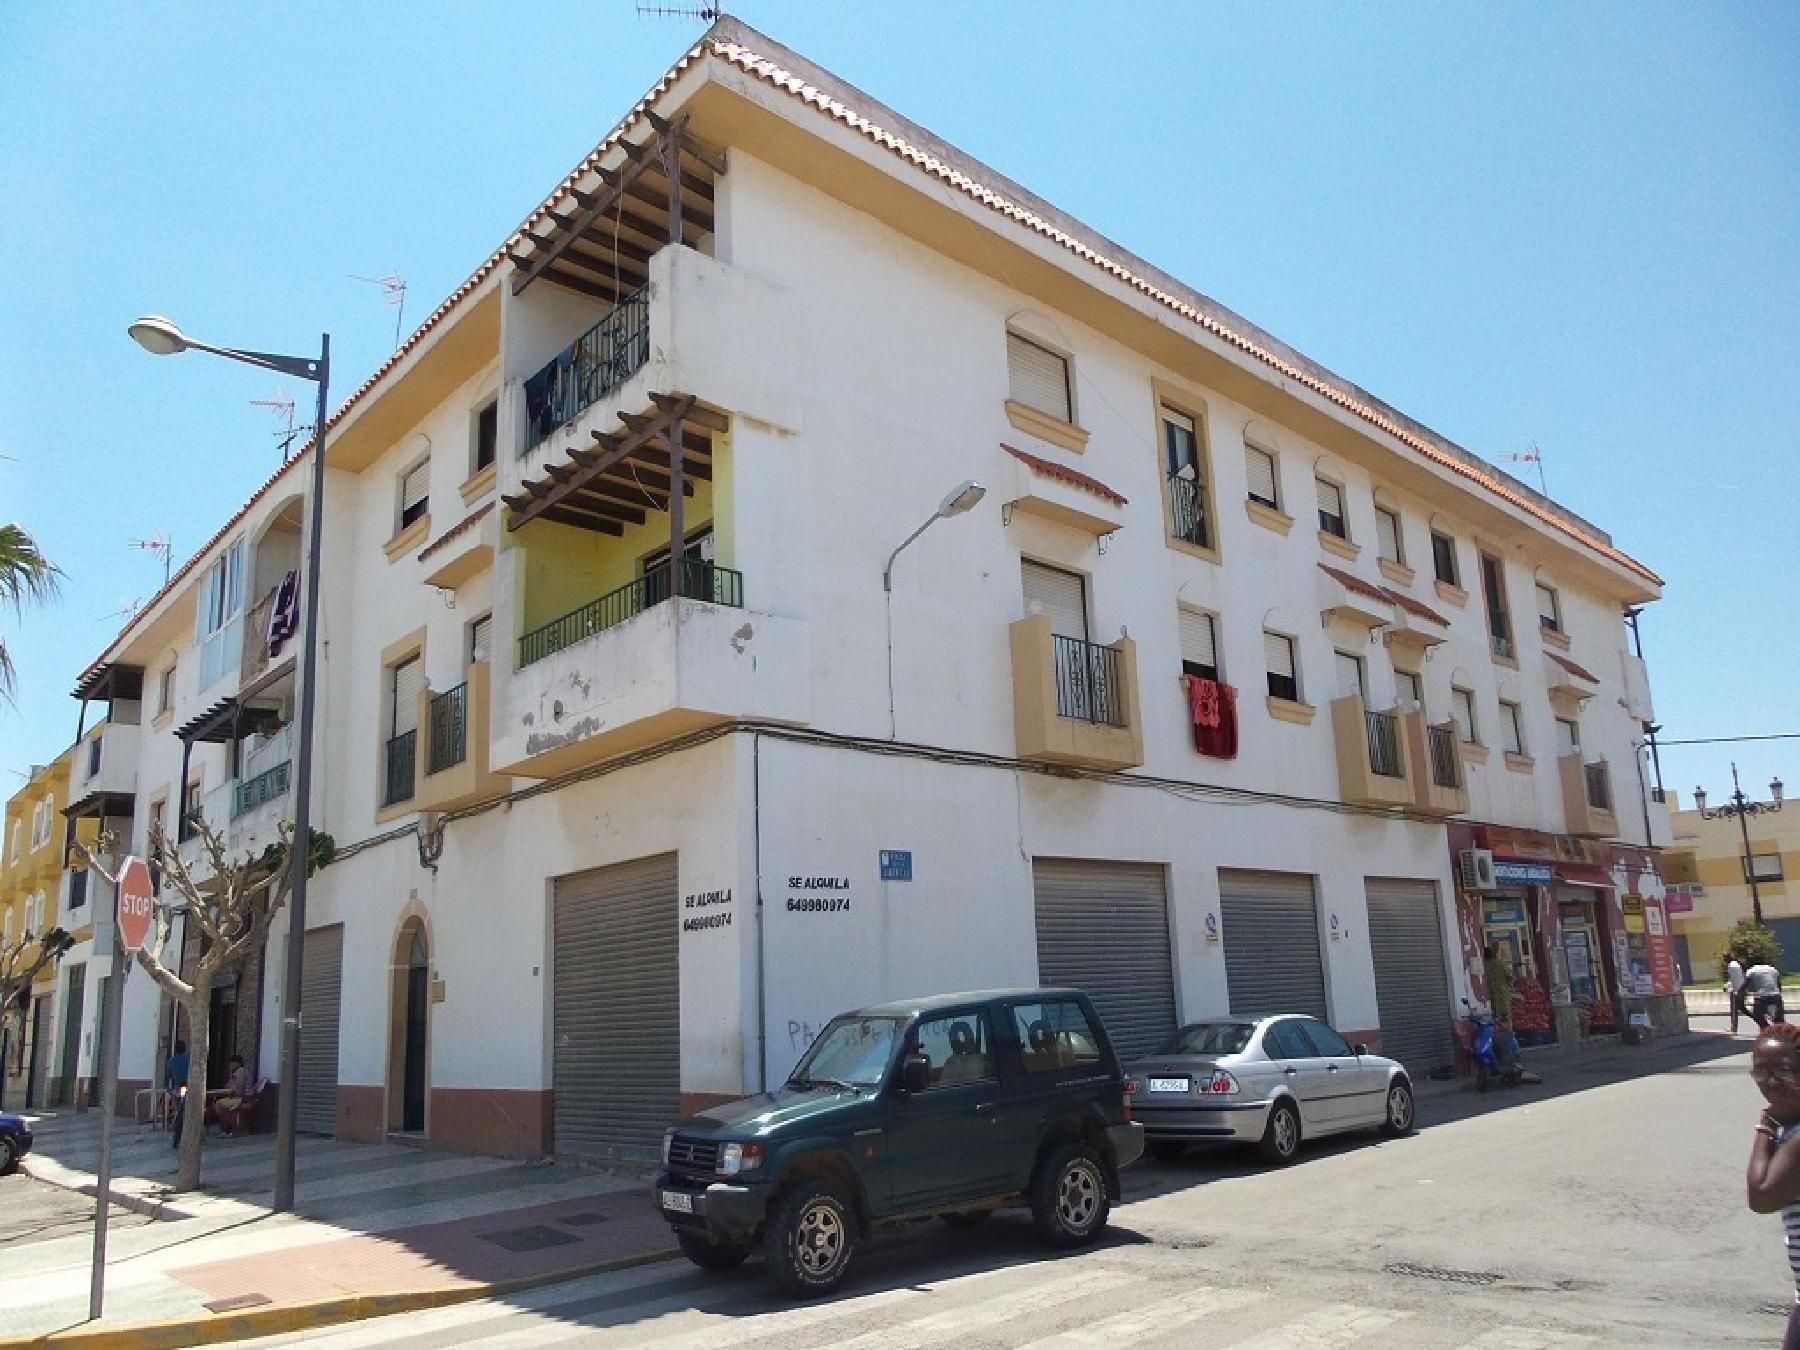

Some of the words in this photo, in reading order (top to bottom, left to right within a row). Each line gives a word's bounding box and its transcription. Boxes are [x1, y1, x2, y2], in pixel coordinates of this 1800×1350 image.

[788, 876, 803, 889] SE
[804, 876, 850, 889] ALQUILA
[122, 893, 149, 917] STOP
[685, 895, 695, 908] SE
[696, 889, 732, 907] ALQUILA
[787, 898, 850, 912] 649980974
